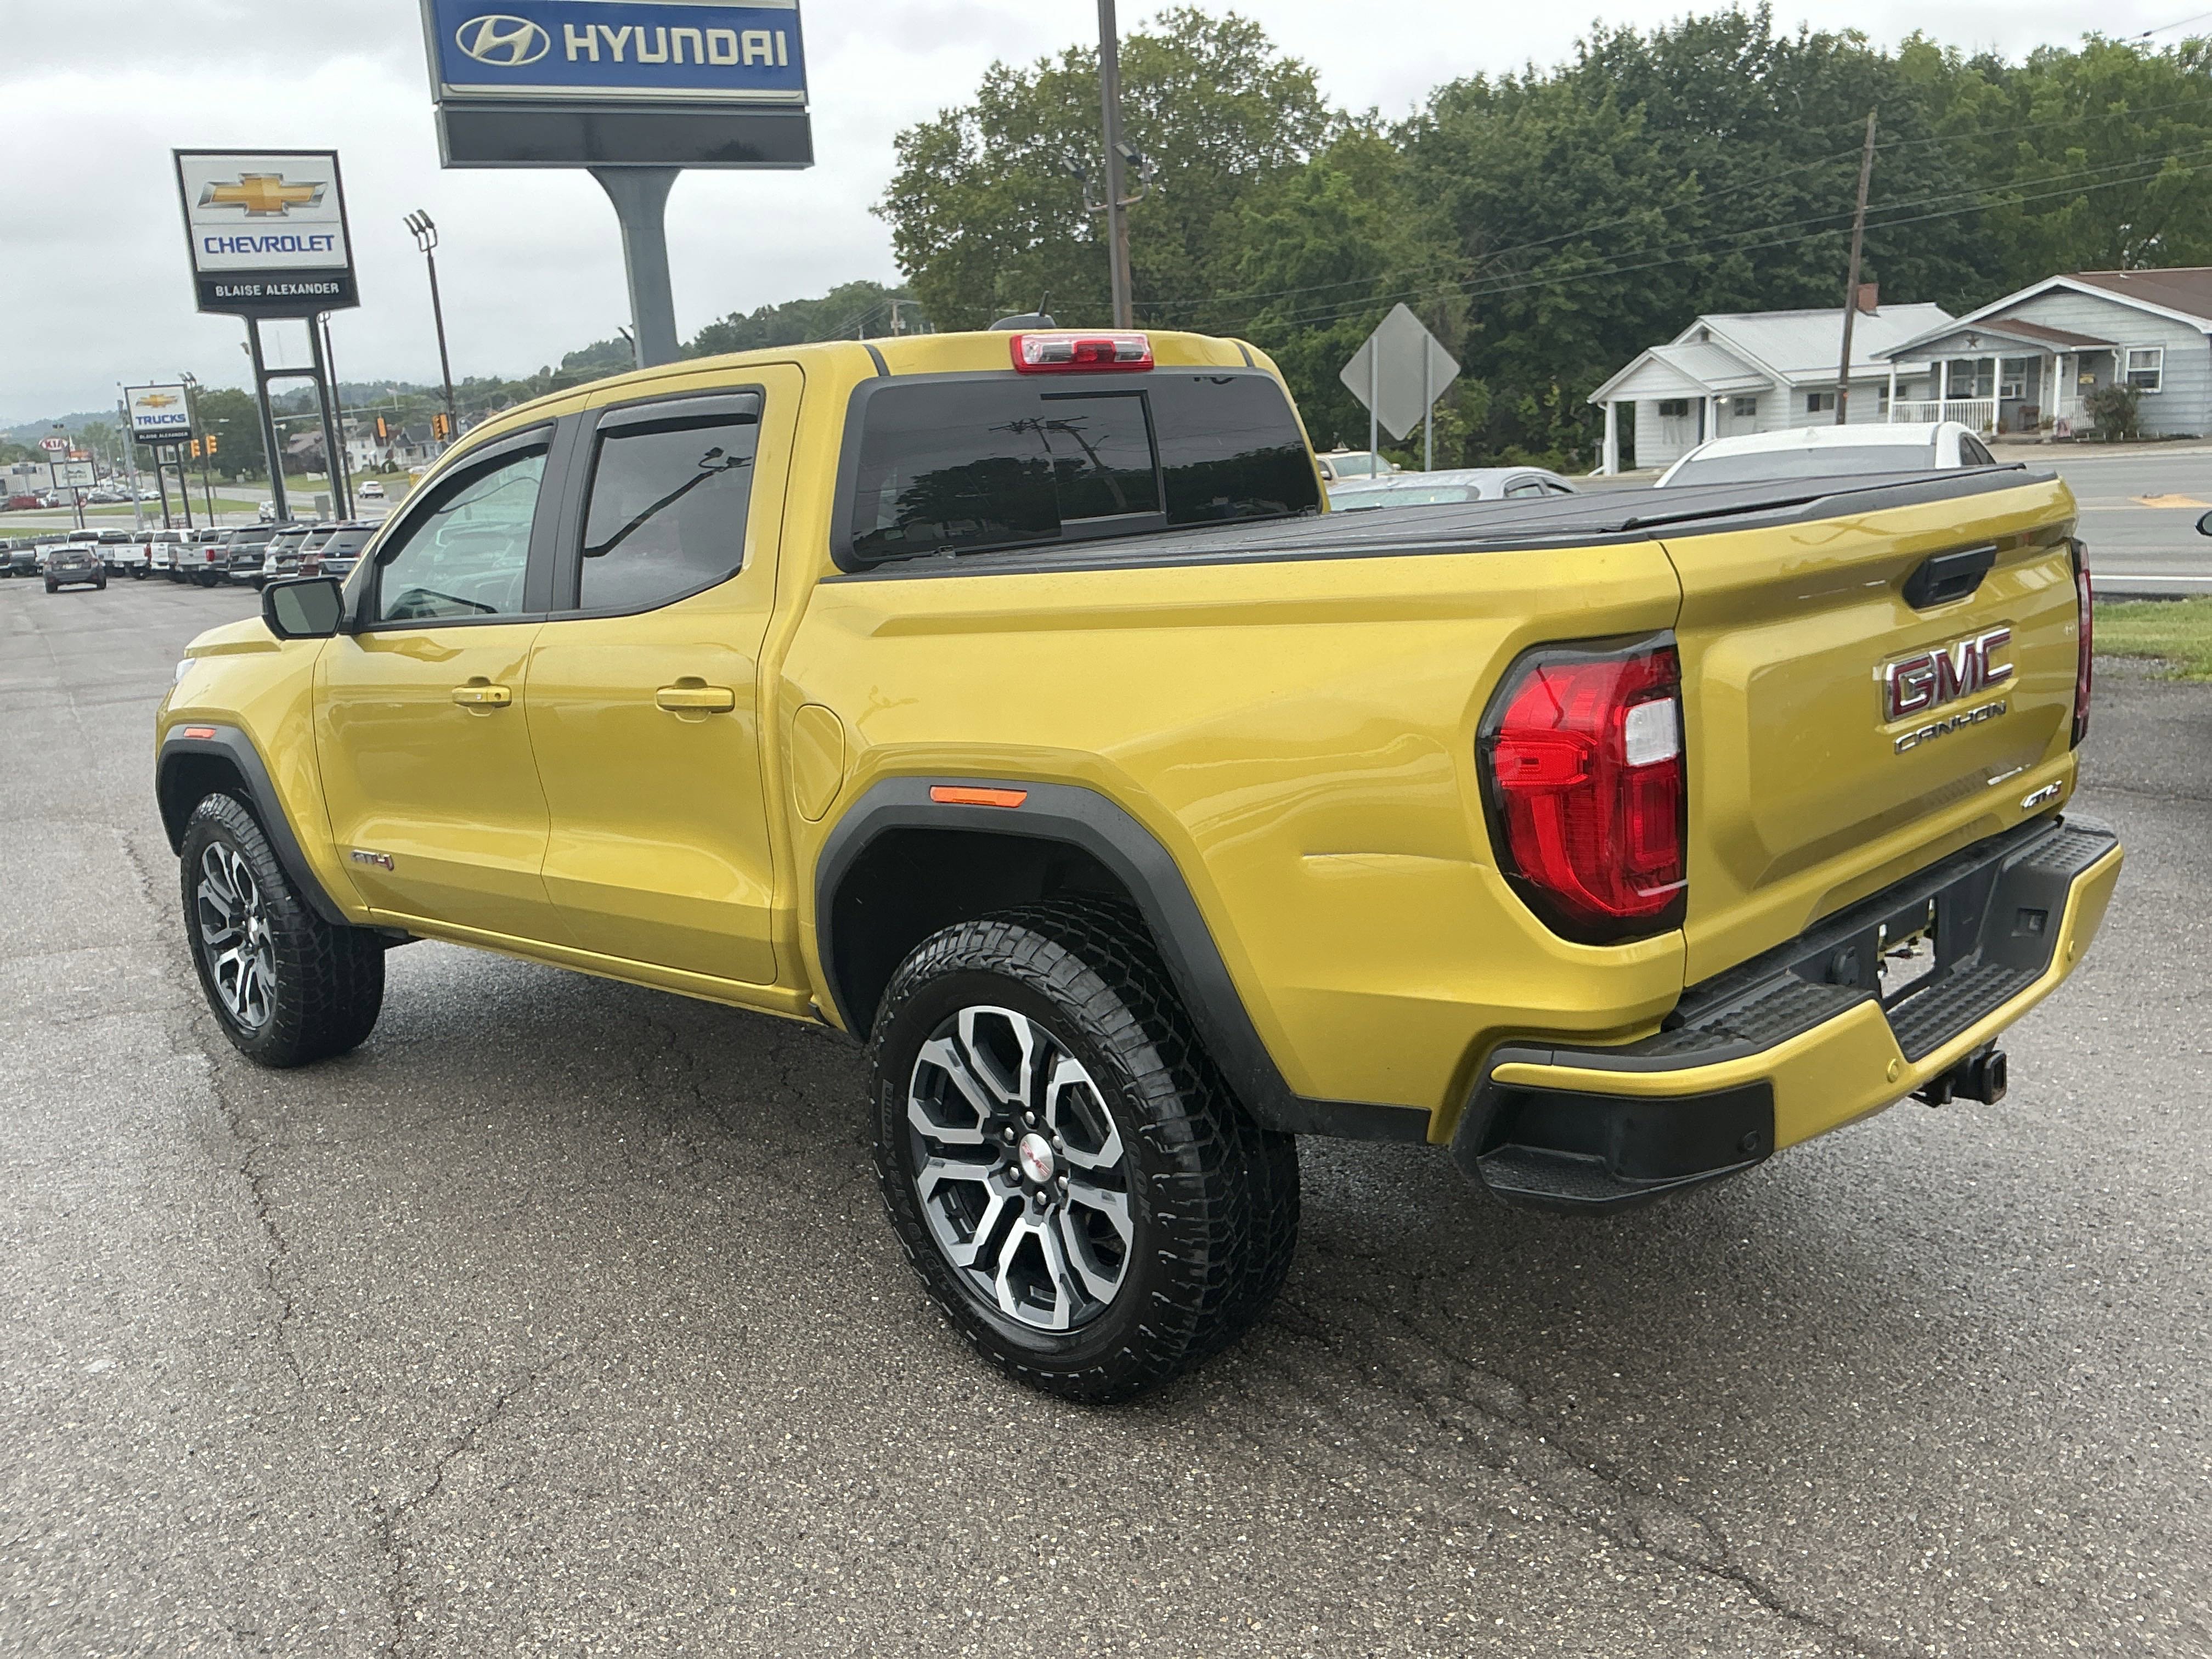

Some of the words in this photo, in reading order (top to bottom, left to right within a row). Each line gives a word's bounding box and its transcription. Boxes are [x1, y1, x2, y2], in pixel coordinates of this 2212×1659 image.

[563, 24, 789, 67] HYUNDAI
[204, 234, 335, 254] CHEVROLET
[215, 284, 262, 297] BLAISE
[266, 282, 340, 296] ALEXANDER
[136, 414, 187, 426] TRUCKS
[1882, 627, 2015, 724] GMC
[1893, 699, 2007, 755] CANYON
